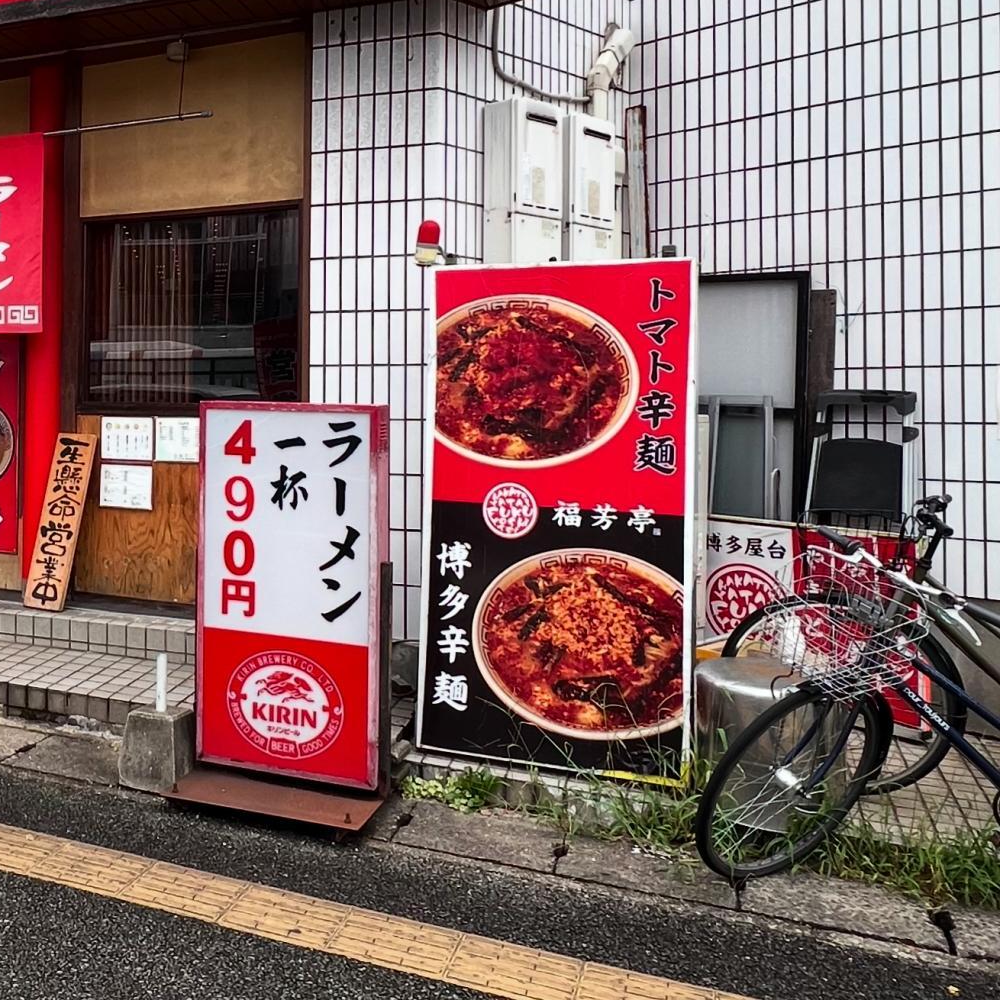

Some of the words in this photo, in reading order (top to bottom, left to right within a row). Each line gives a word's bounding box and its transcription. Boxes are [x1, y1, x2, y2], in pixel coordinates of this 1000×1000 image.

[633, 277, 678, 476] トマト辛麺
[270, 435, 309, 512] 一杯
[31, 437, 90, 606] 一生懸命営業中
[220, 419, 257, 618] 490円
[318, 420, 363, 623] ラーメン
[551, 500, 657, 534] 福芳亭
[706, 534, 787, 560] 博多屋台
[432, 541, 472, 712] 博多辛麺
[236, 662, 257, 682] KIRIN
[257, 654, 298, 666] BREWERY
[230, 701, 252, 736] BREWED
[249, 731, 266, 747] FOR
[270, 741, 296, 754] BEER
[301, 738, 323, 754] GOOD
[322, 719, 340, 741] TIMES
[252, 701, 317, 729] KIRIN
